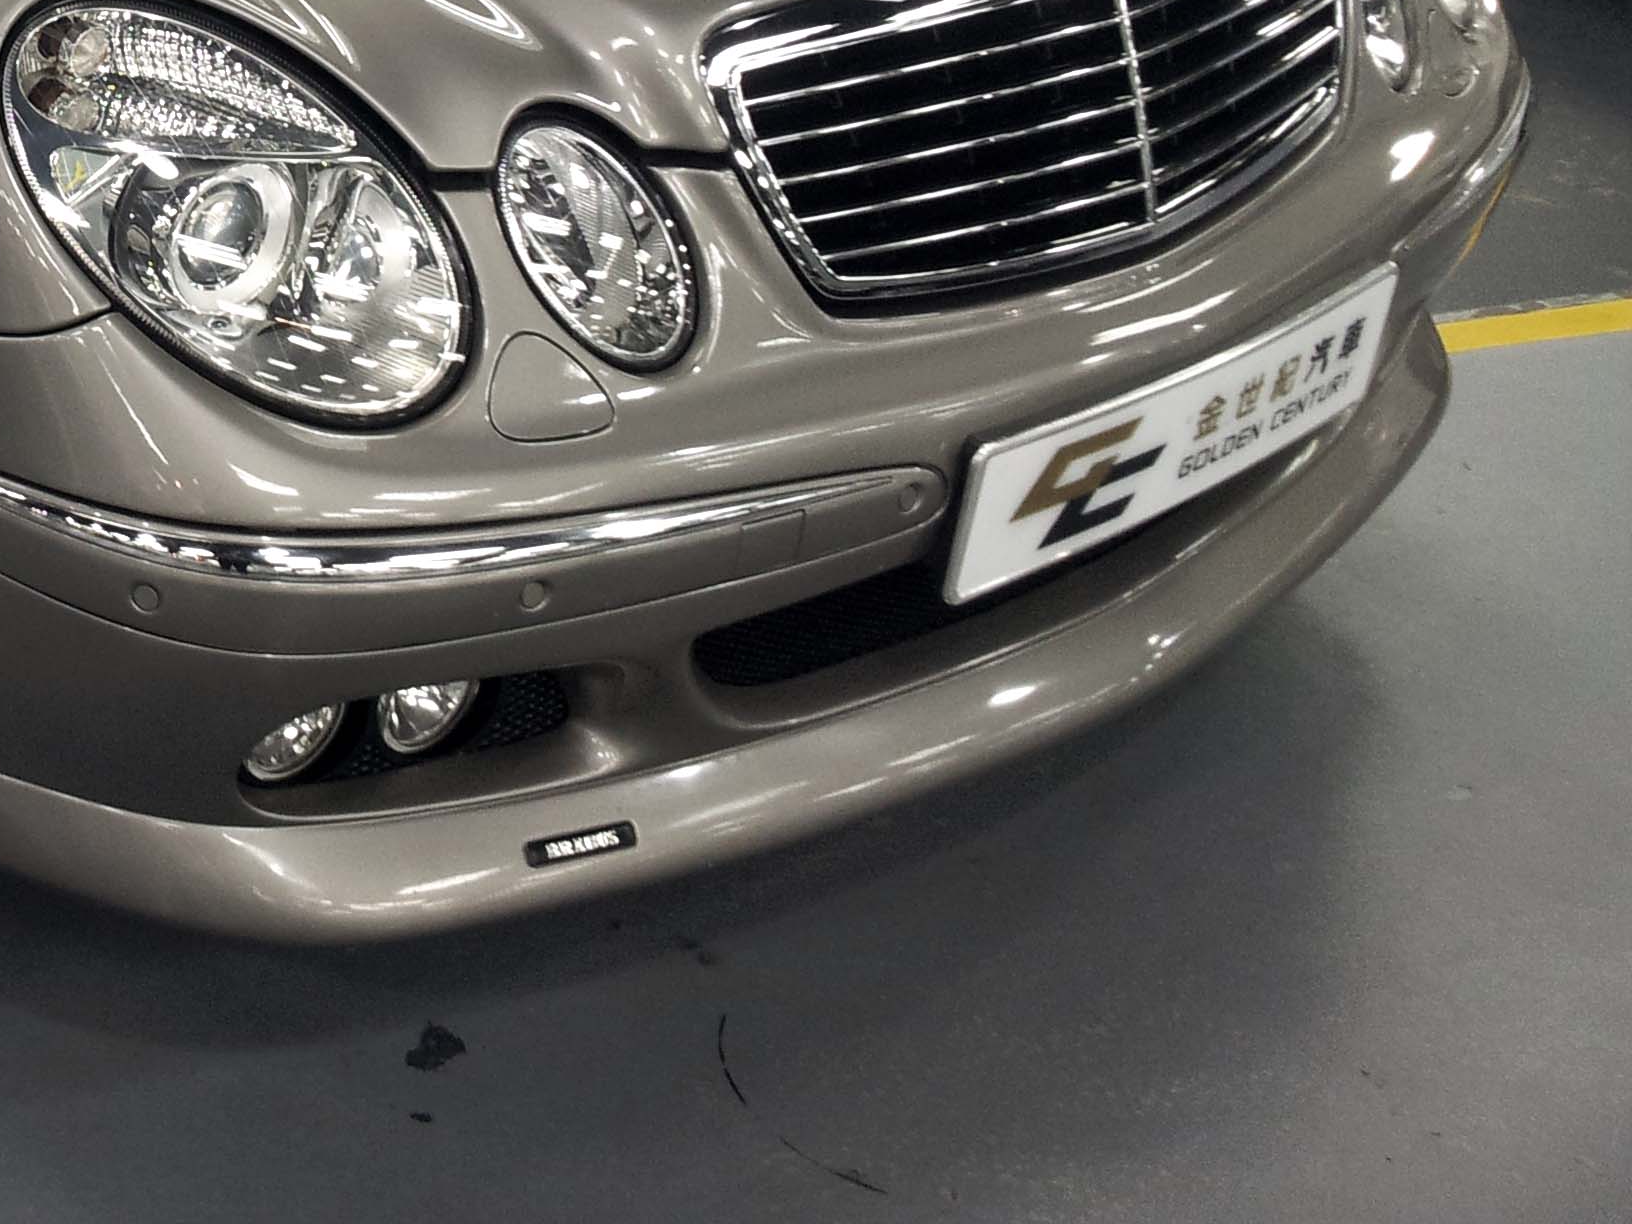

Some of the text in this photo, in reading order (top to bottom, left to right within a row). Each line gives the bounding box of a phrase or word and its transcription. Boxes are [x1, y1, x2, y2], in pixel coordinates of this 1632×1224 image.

[1177, 366, 1353, 479] GOLDEN CENTURY
[1192, 316, 1367, 442] 金世紀汽車
